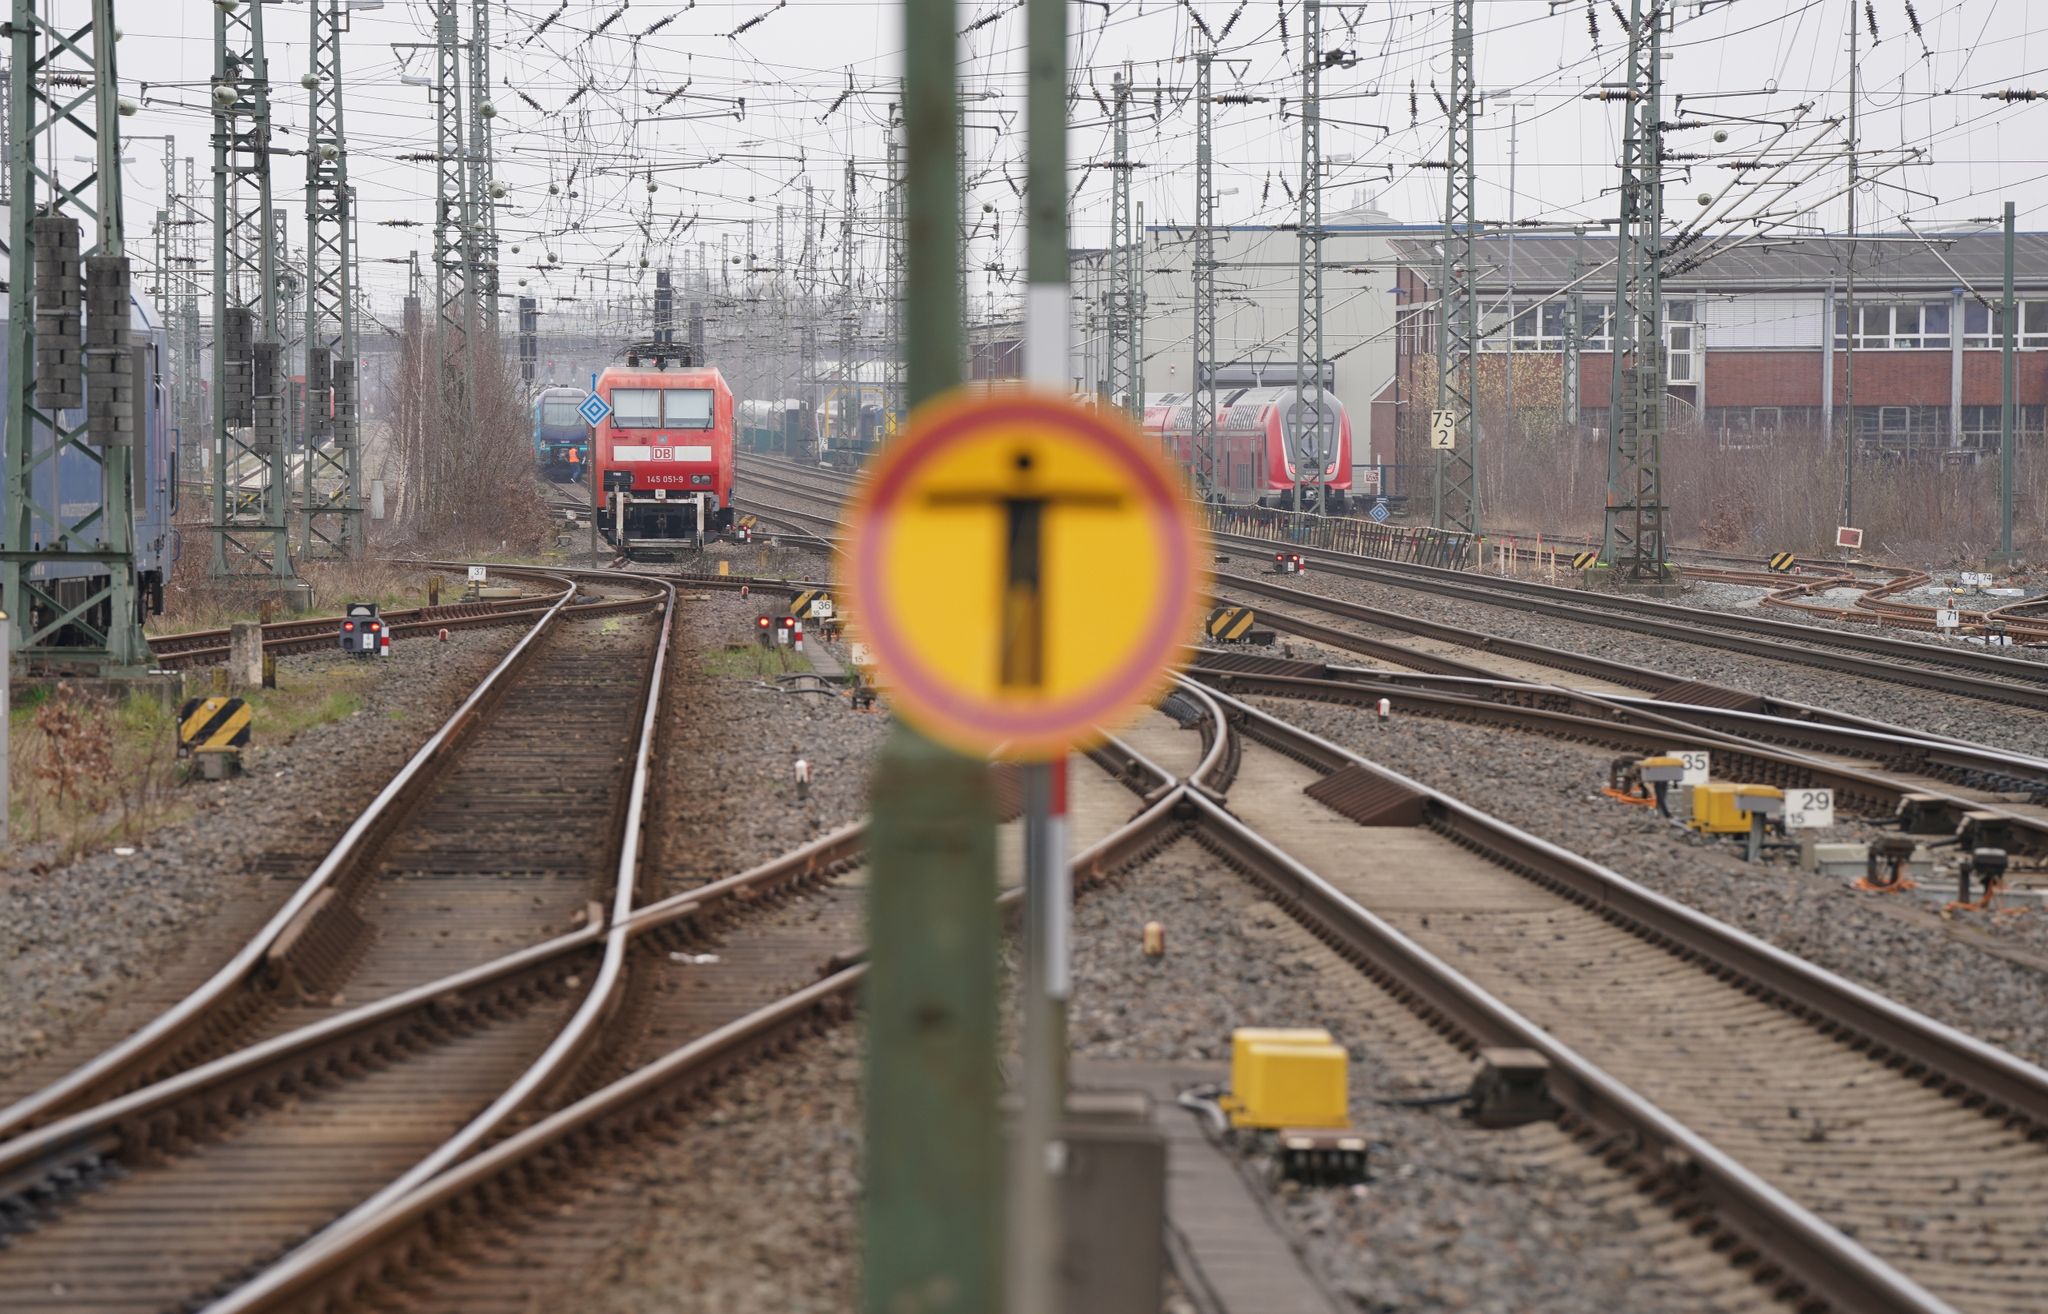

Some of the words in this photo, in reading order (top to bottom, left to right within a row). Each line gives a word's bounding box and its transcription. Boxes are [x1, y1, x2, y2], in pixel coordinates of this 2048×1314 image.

[1433, 412, 1454, 428] 75
[1438, 430, 1448, 445] 2
[654, 448, 672, 459] DB
[474, 567, 484, 576] 37
[818, 601, 831, 610] 36
[1947, 611, 1957, 620] 71
[1681, 754, 1707, 771] 35
[1801, 791, 1830, 811] 29
[1790, 813, 1804, 824] 15
